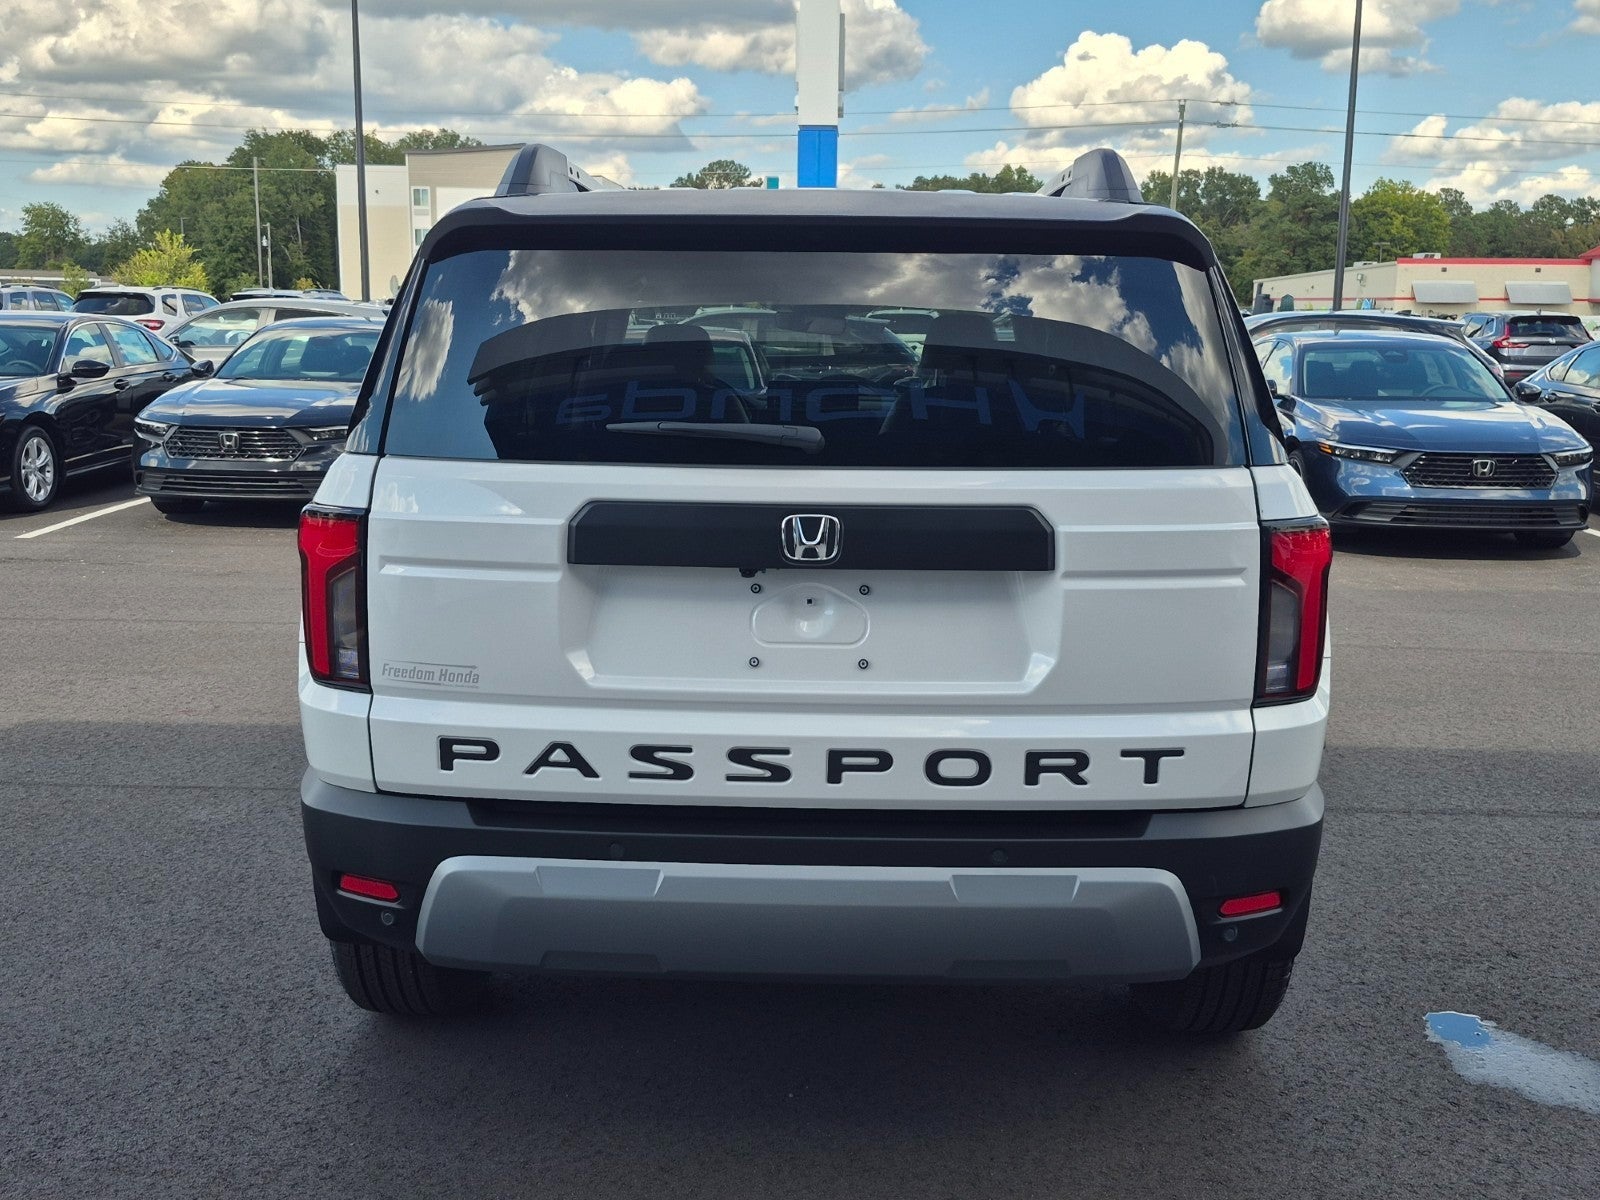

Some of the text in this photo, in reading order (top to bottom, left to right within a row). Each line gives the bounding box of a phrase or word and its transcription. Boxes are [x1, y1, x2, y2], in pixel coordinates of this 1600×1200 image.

[382, 663, 480, 684] Freedom Honda
[438, 736, 1185, 788] PASSPORT
